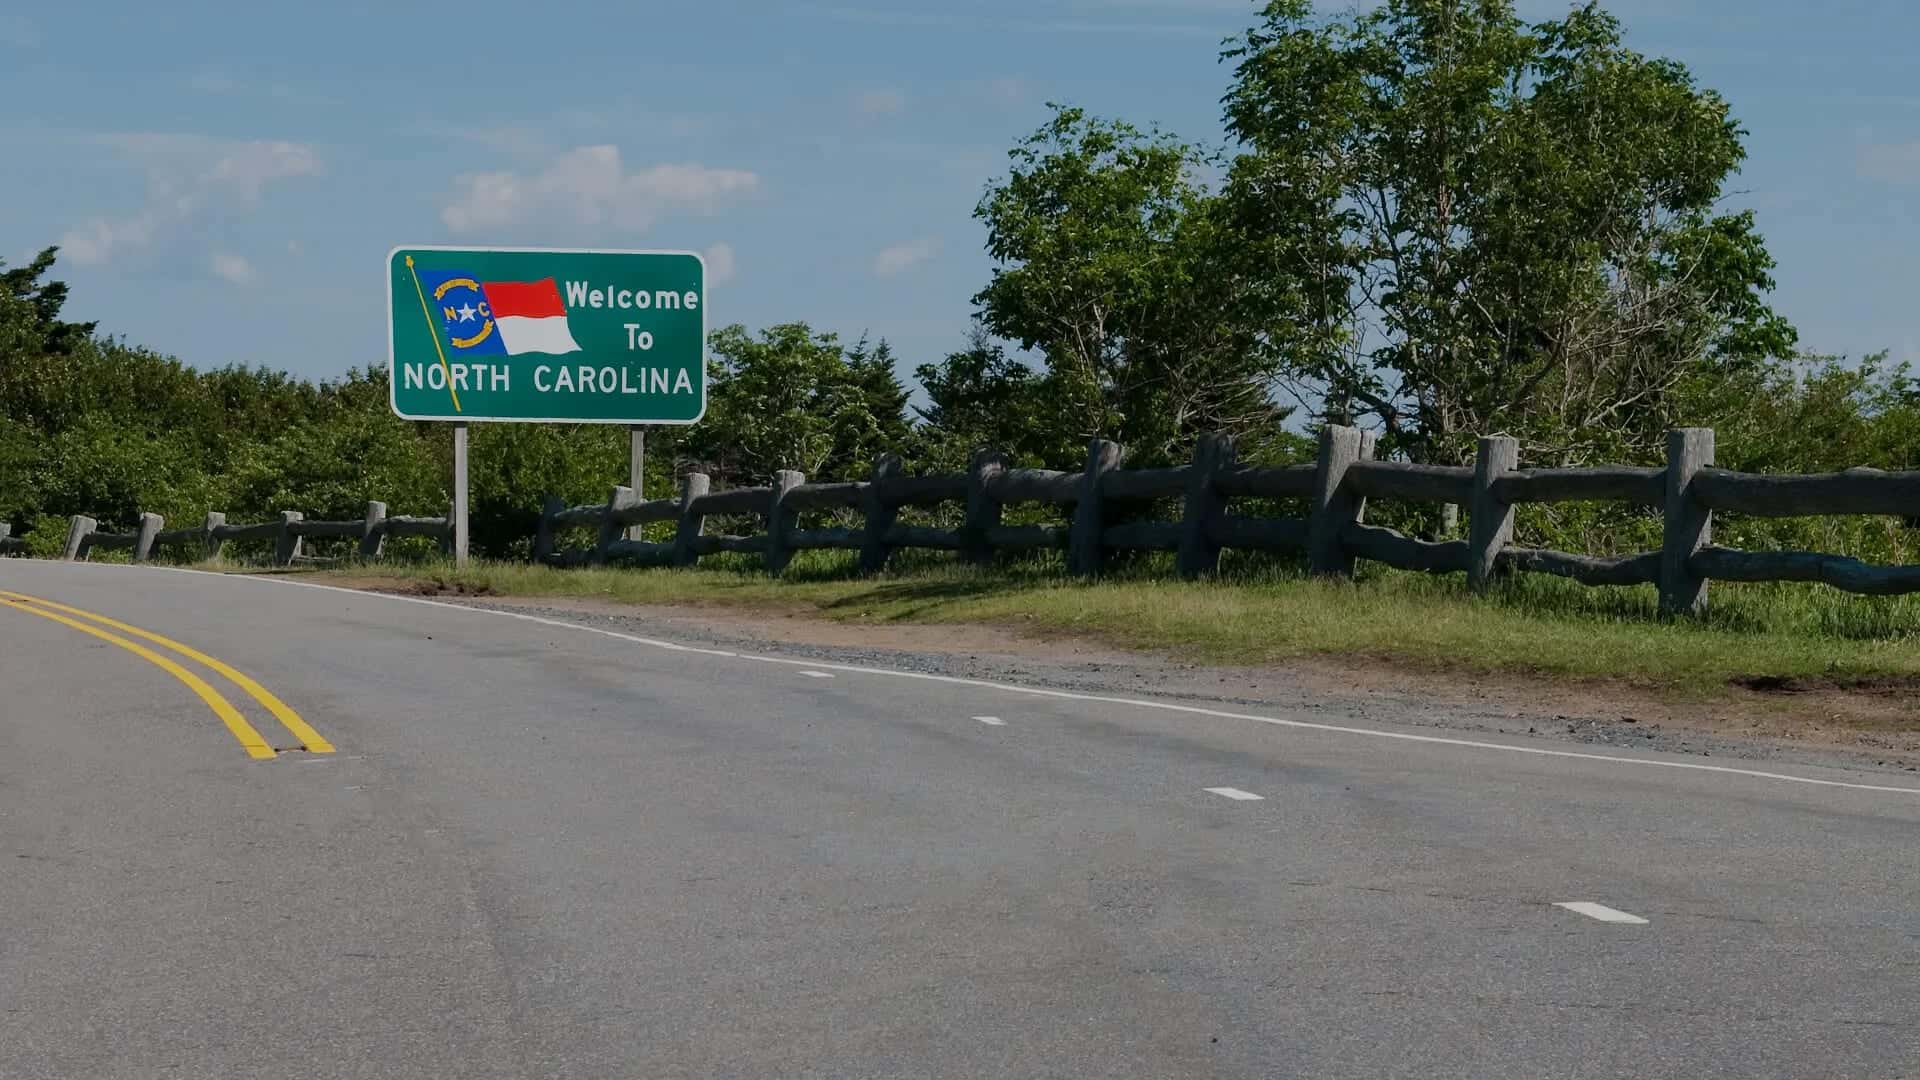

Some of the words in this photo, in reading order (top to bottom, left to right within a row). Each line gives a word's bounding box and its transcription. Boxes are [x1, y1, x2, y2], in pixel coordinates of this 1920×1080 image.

[565, 280, 699, 310] Welcome
[443, 306, 458, 321] N
[478, 301, 490, 317] C
[623, 323, 654, 351] To
[403, 362, 510, 392] NORTH
[533, 365, 695, 395] CAROLINA
